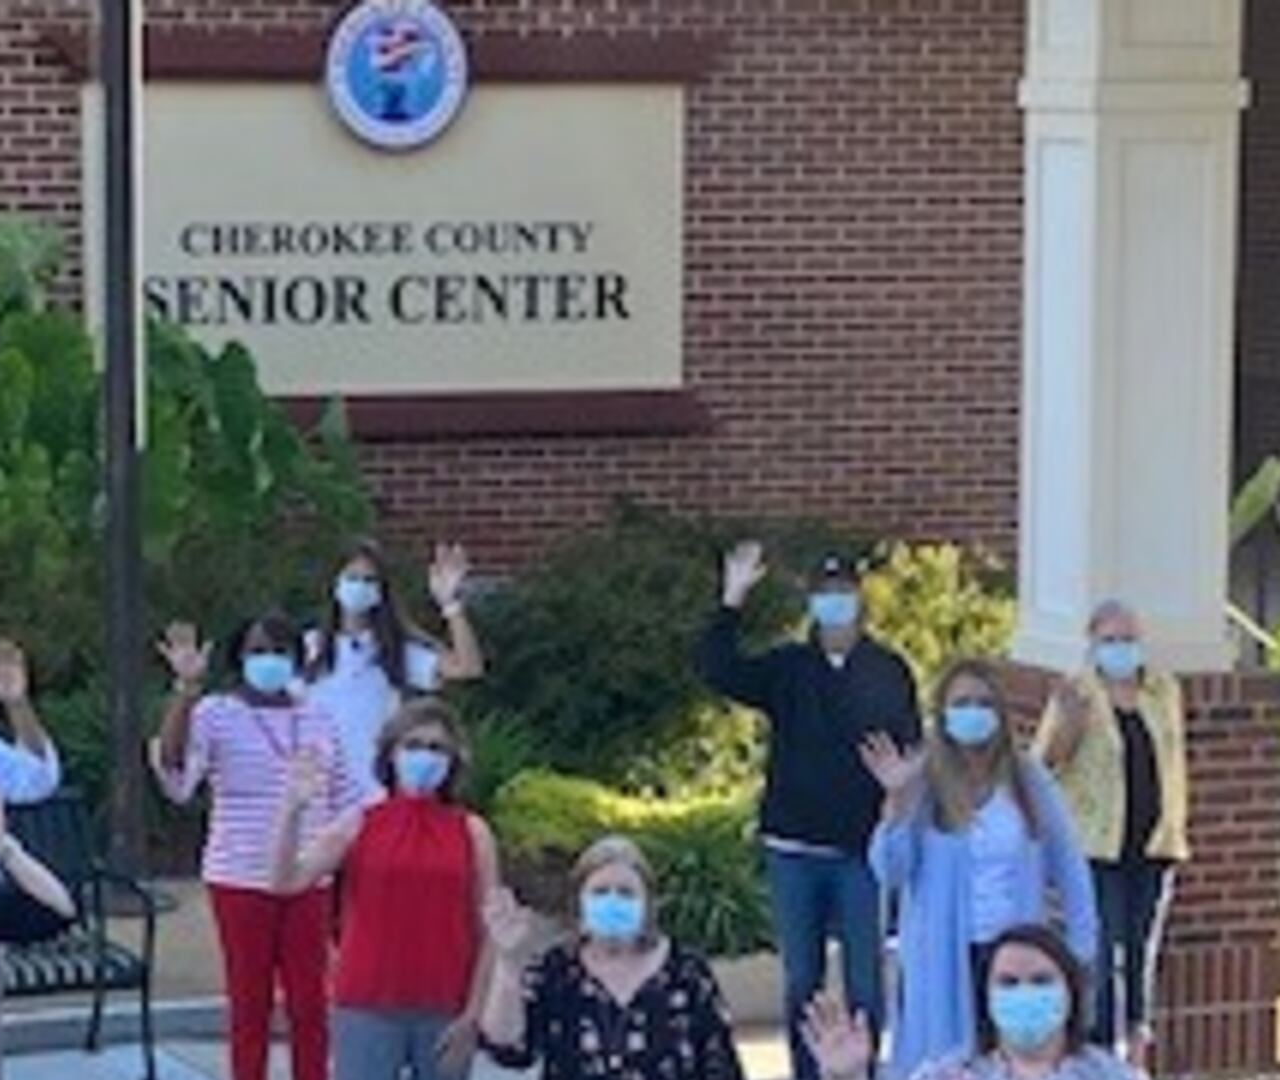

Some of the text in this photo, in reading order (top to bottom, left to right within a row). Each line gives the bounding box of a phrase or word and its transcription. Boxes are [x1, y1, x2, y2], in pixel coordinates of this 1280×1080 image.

[179, 221, 593, 257] CHEROKEE COUNTY
[143, 272, 631, 325] SENIOR CENTER
